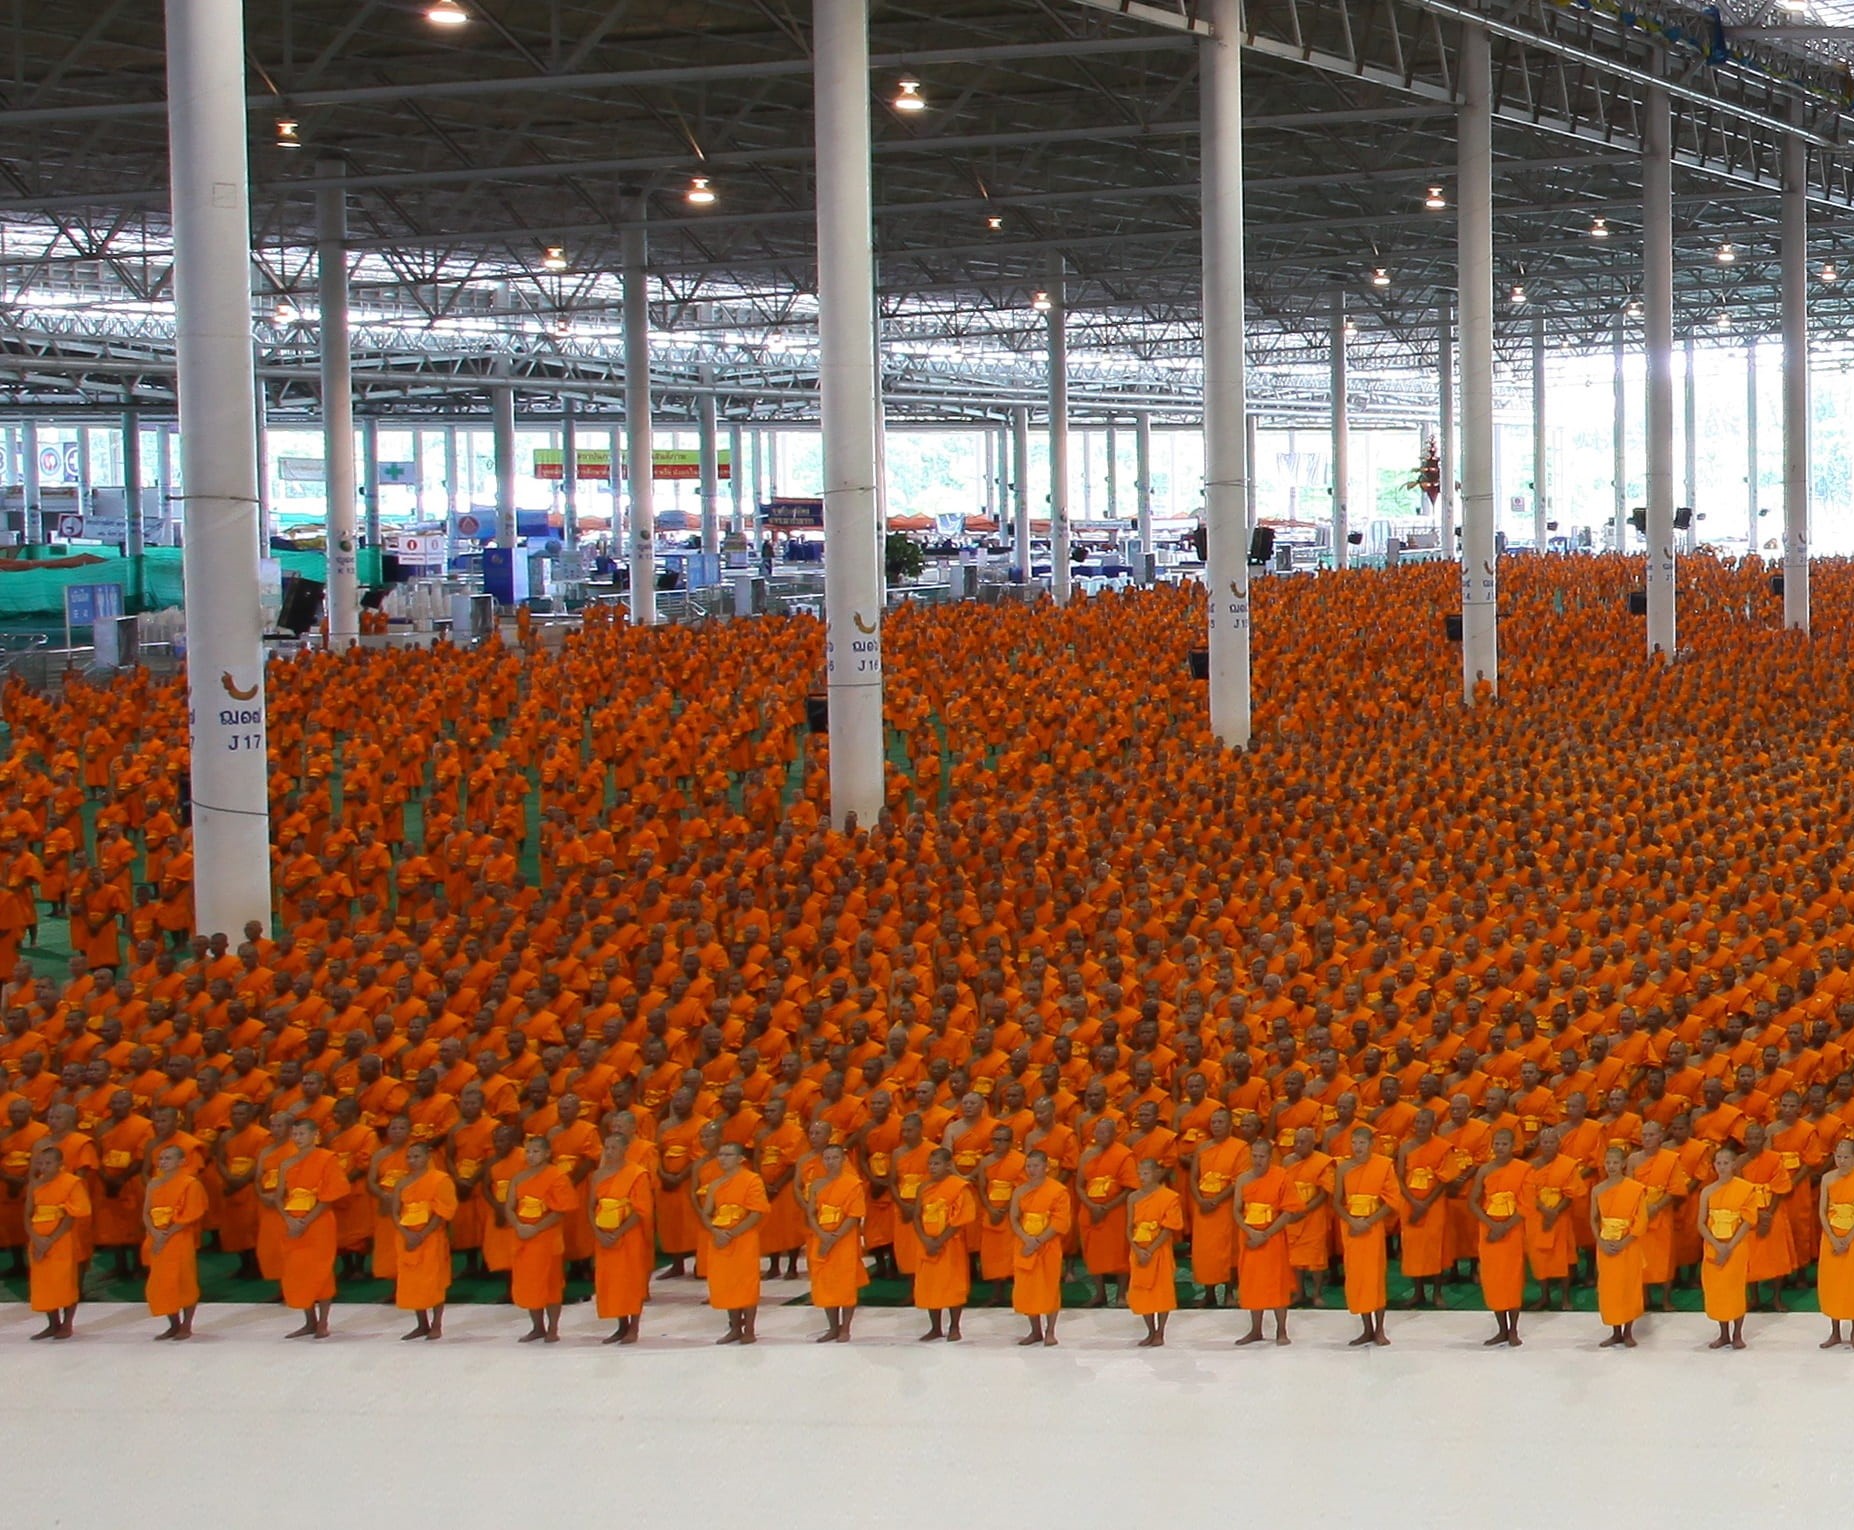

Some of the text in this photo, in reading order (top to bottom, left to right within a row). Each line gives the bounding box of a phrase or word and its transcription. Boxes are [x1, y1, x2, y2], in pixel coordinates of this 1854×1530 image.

[857, 660, 865, 671] J
[228, 734, 261, 750] J 17
